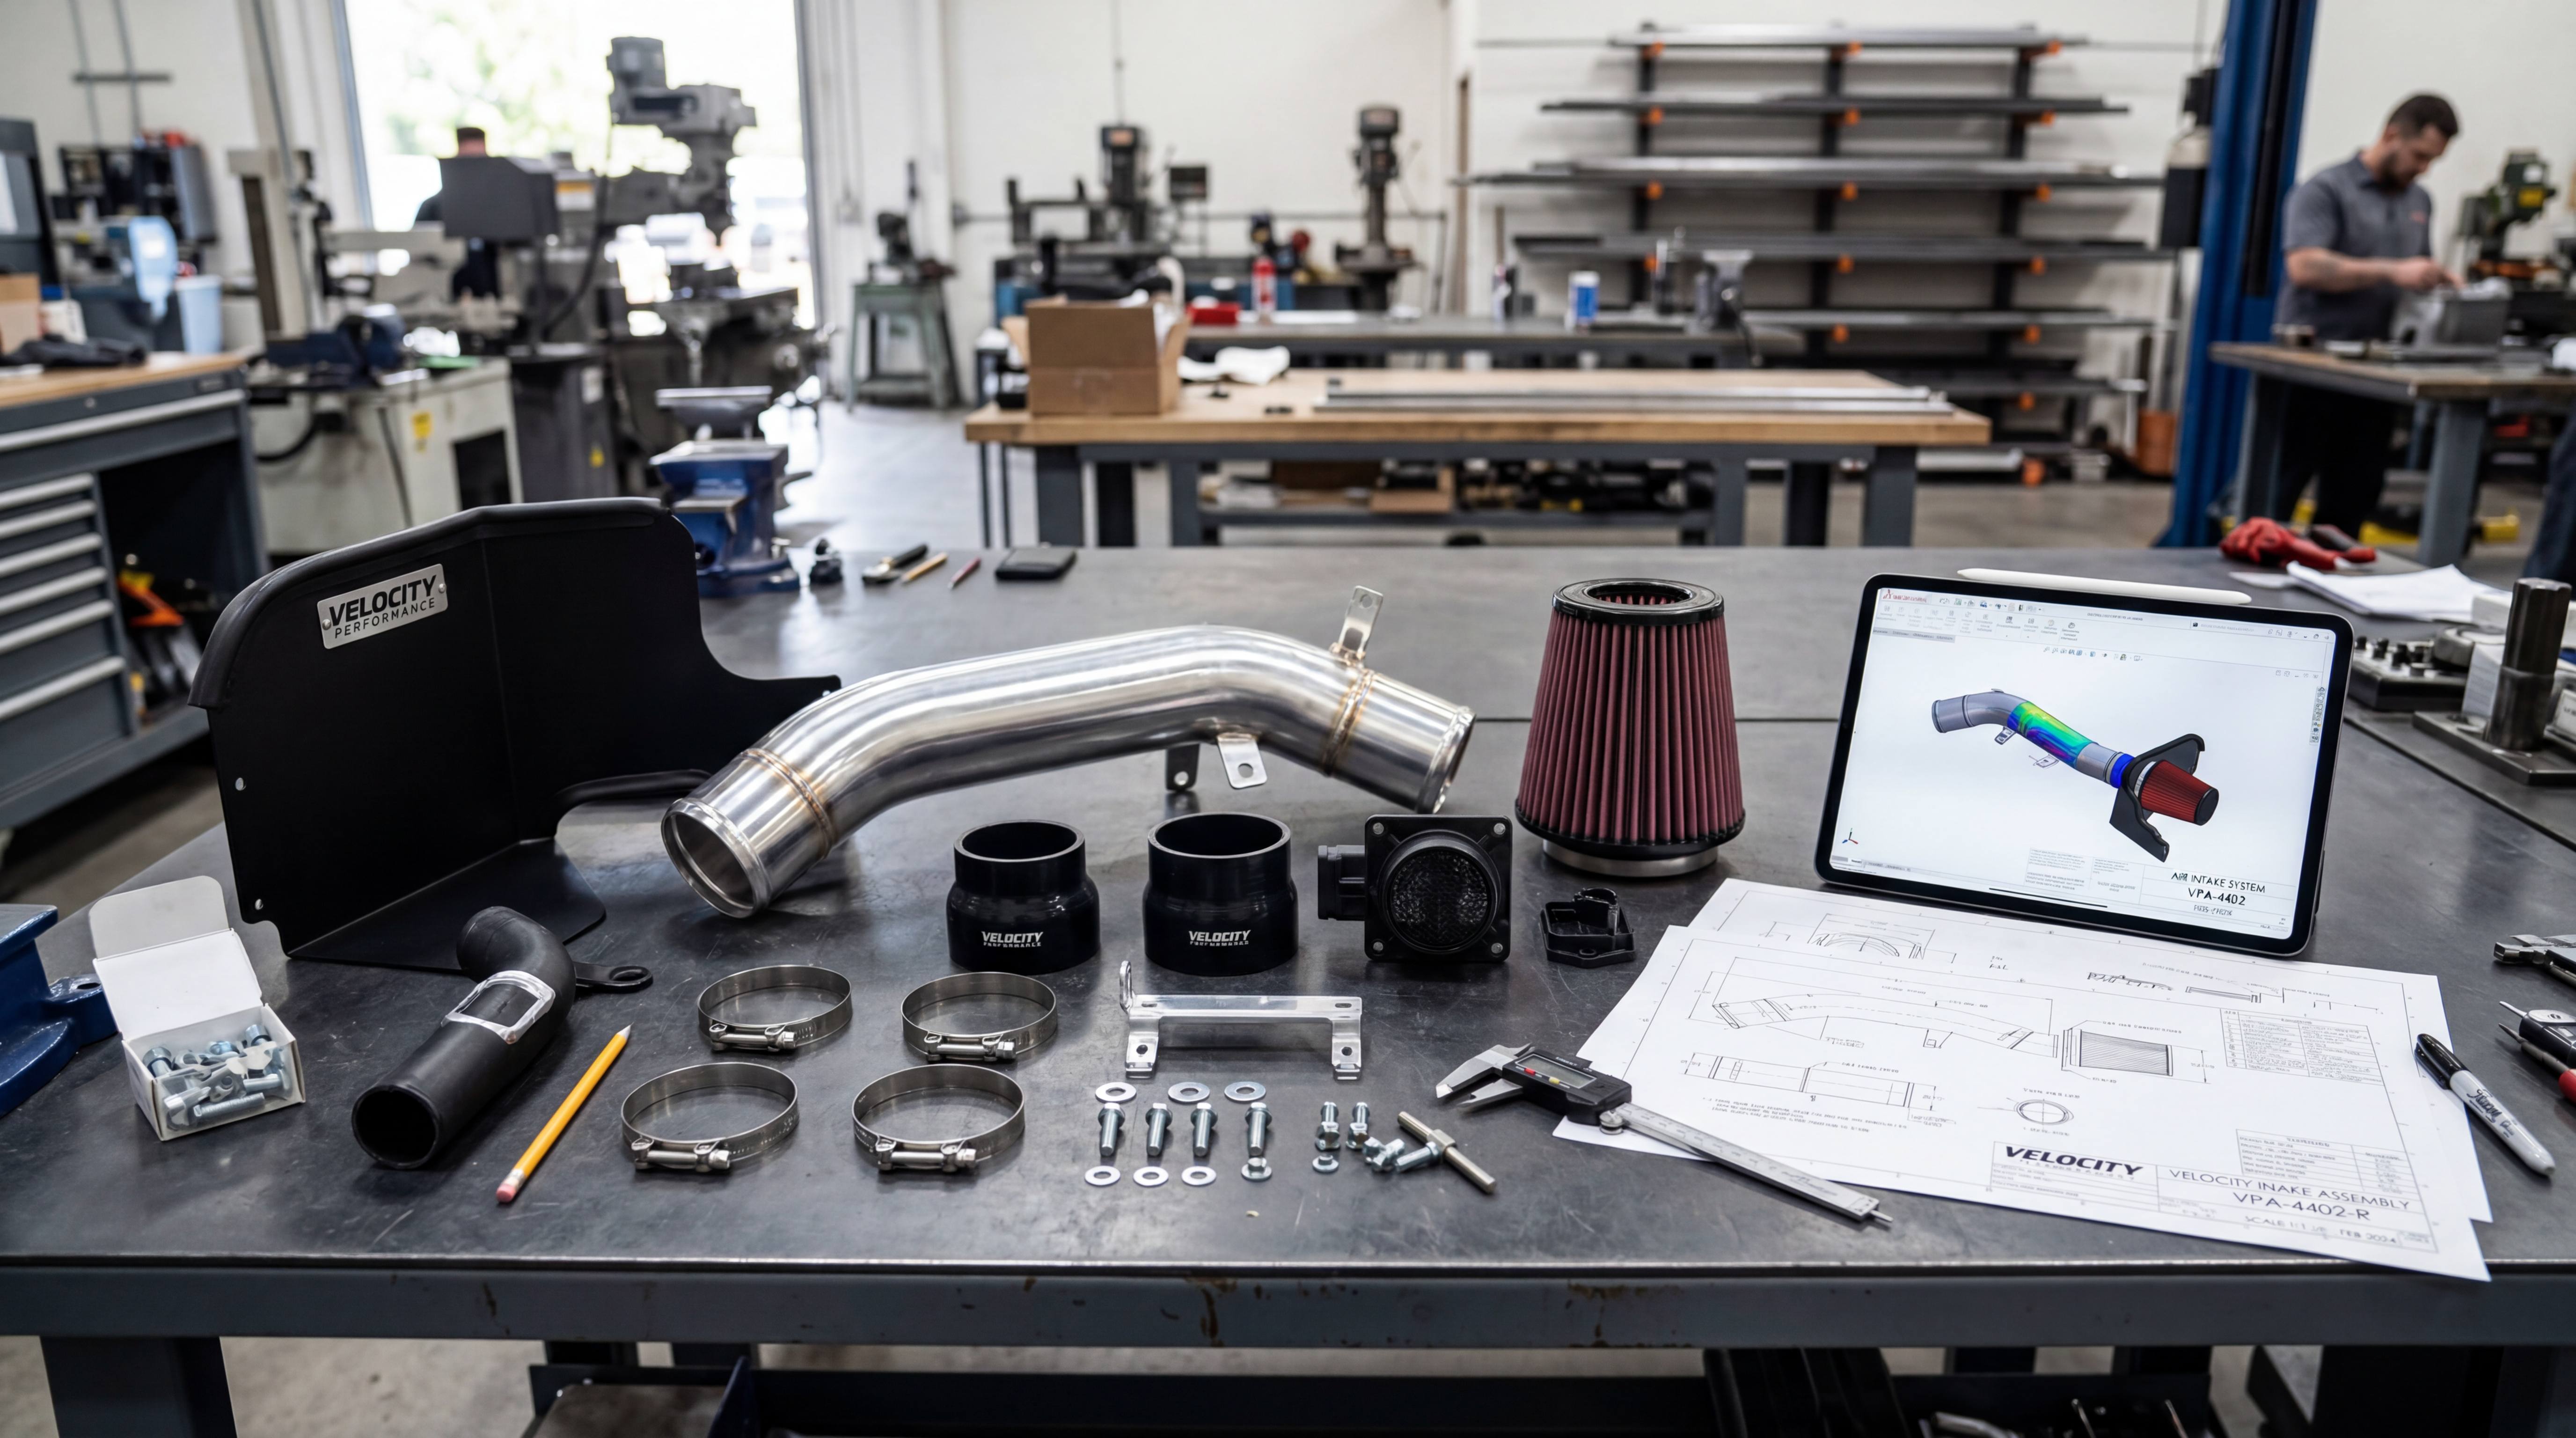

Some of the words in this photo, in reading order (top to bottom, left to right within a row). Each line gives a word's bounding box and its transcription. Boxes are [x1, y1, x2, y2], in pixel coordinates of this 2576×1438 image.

[329, 575, 437, 626] VELOCITY
[335, 597, 435, 638] PERFORMANCE
[2191, 875, 2226, 888] INTAKE
[2228, 880, 2266, 893] SYSTEM
[2188, 888, 2246, 906] VPA-4402
[981, 931, 1044, 943] VELOCITY
[1189, 930, 1251, 942] VELOCITY
[2006, 1146, 2144, 1175] VELOCITY
[2169, 1169, 2253, 1188] VELOCITY
[2258, 1181, 2313, 1196] INAKE
[2318, 1190, 2409, 1210] ASSEMBLY
[2233, 1192, 2371, 1221] VPA-4402-R
[2245, 1216, 2285, 1227] SCALE
